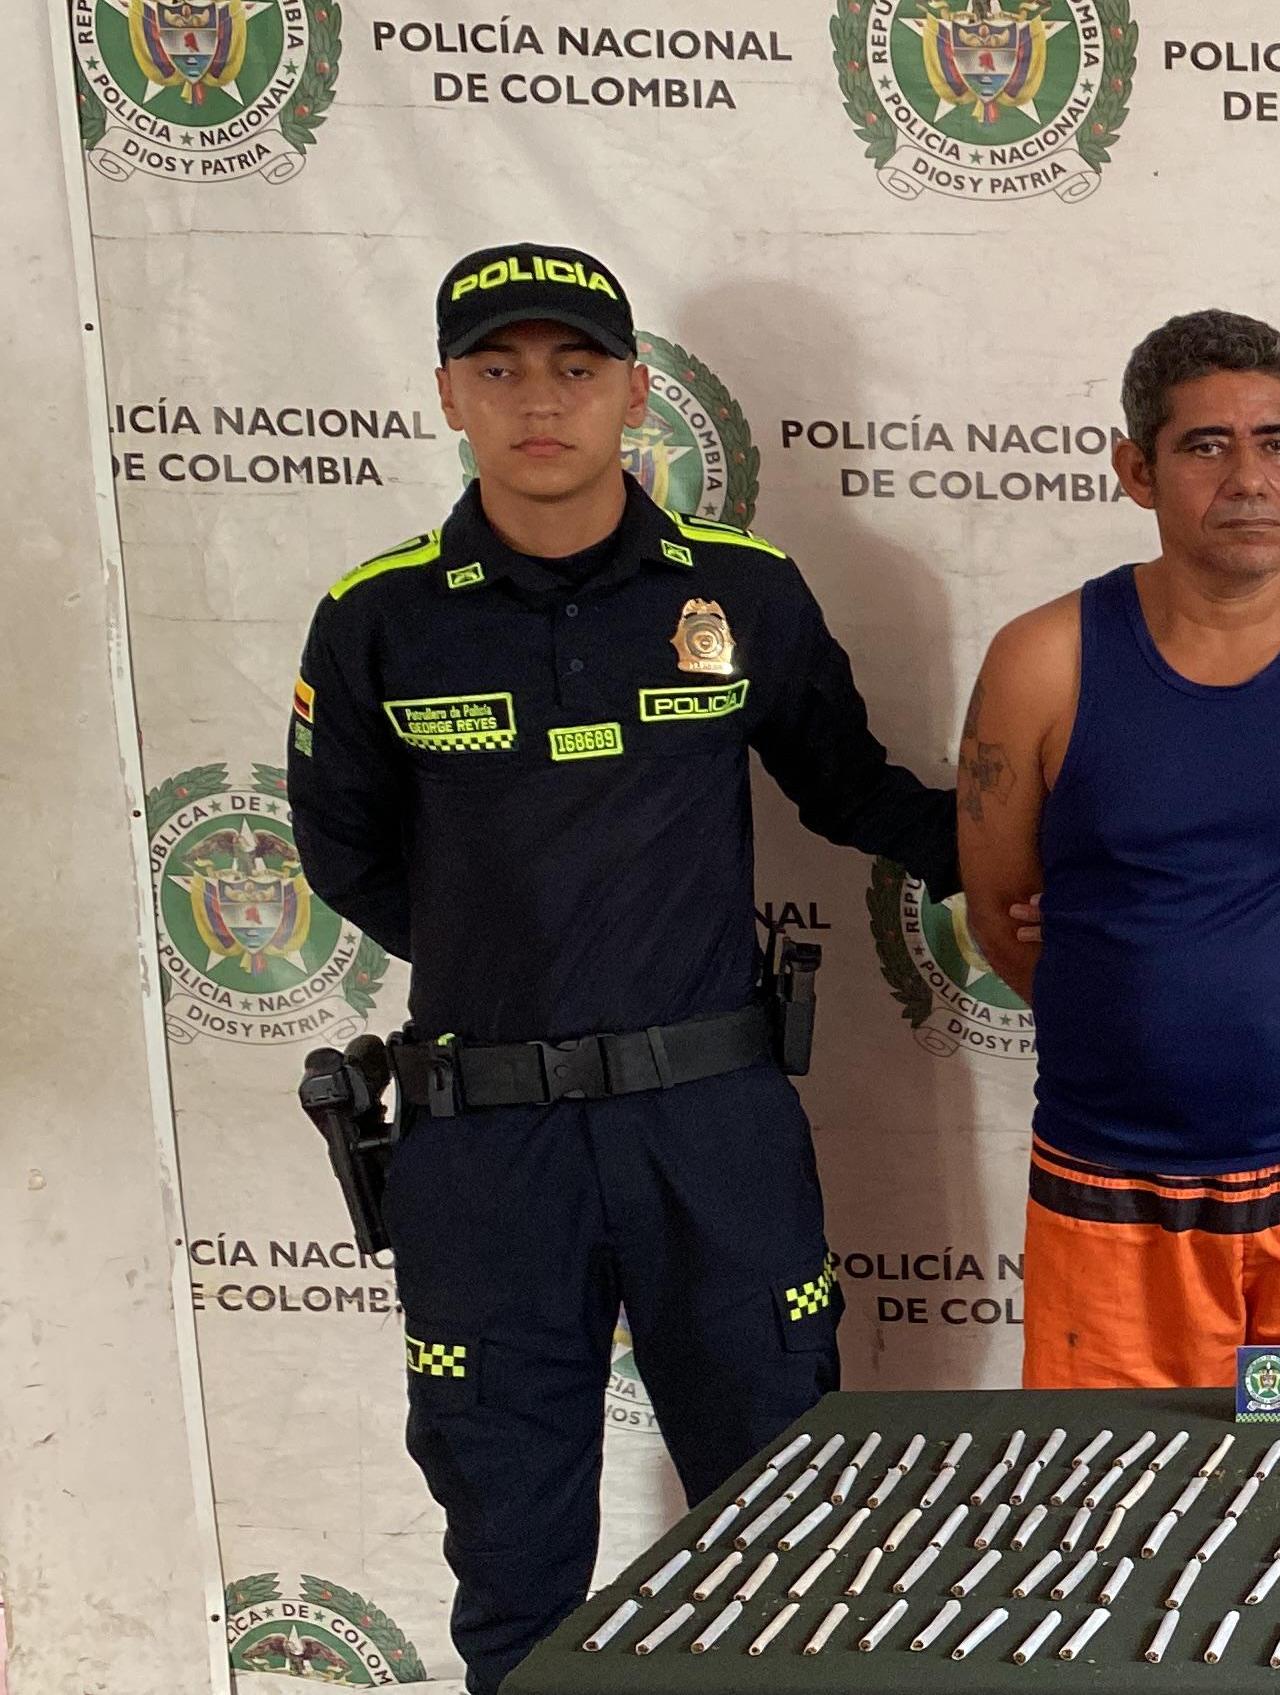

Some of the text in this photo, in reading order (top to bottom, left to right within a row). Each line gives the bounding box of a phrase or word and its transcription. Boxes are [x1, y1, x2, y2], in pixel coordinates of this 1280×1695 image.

[372, 15, 793, 61] POLICÍA NACIONAL
[433, 72, 737, 109] DE COLOMBIA
[1223, 91, 1278, 122] DE
[93, 74, 295, 146] POLICÍA NACIONAL
[885, 93, 1090, 165] POLICÍA NACIONAL
[202, 142, 271, 175] PATRIA
[990, 161, 1066, 193] PATRIA
[451, 256, 618, 301] POLICÍA
[108, 397, 436, 439] ICÍA NACIONAL
[650, 375, 722, 491] COLOMBIA
[781, 415, 1130, 455] POLICÍA NACIO
[159, 453, 384, 486] COLOMBIA
[840, 469, 895, 498] DE
[408, 716, 497, 733] GEORGE REYES
[557, 729, 615, 752] 168689
[230, 795, 260, 811] DE
[158, 946, 355, 1012] POLICÍA NACIONAL
[920, 961, 991, 1023] POLICÍA
[260, 1008, 335, 1038] PATRIA
[217, 1285, 392, 1313] COLOMB
[877, 1296, 928, 1324] DE
[282, 1603, 309, 1618] DE
